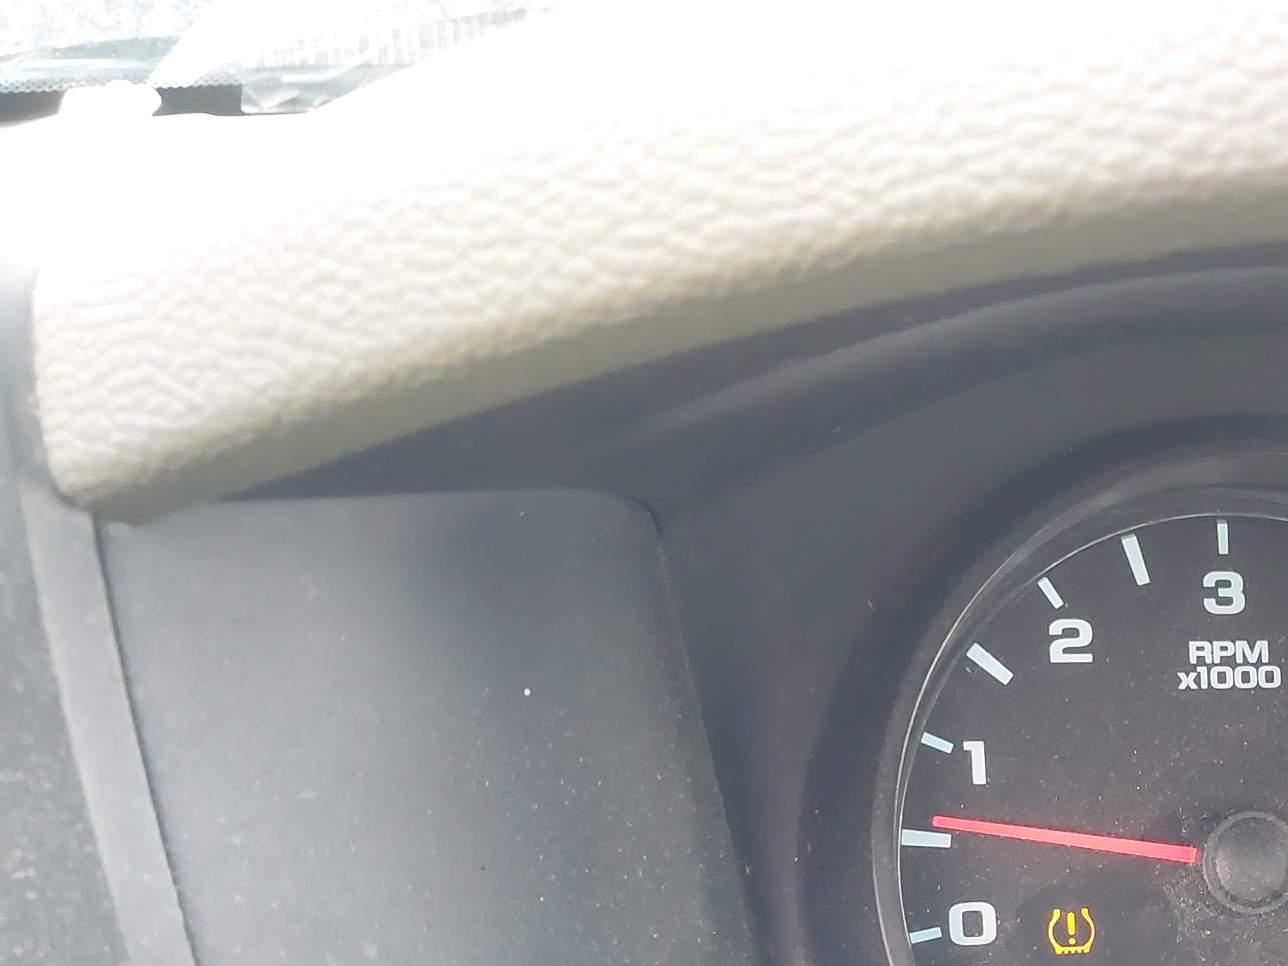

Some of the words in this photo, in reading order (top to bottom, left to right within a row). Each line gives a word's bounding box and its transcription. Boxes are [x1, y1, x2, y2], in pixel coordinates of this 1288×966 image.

[1203, 571, 1246, 614] 3
[1049, 619, 1094, 663] 2
[1189, 640, 1269, 665] RPM
[1177, 665, 1281, 690] x1000
[963, 741, 986, 784] 1
[949, 902, 996, 946] 0
